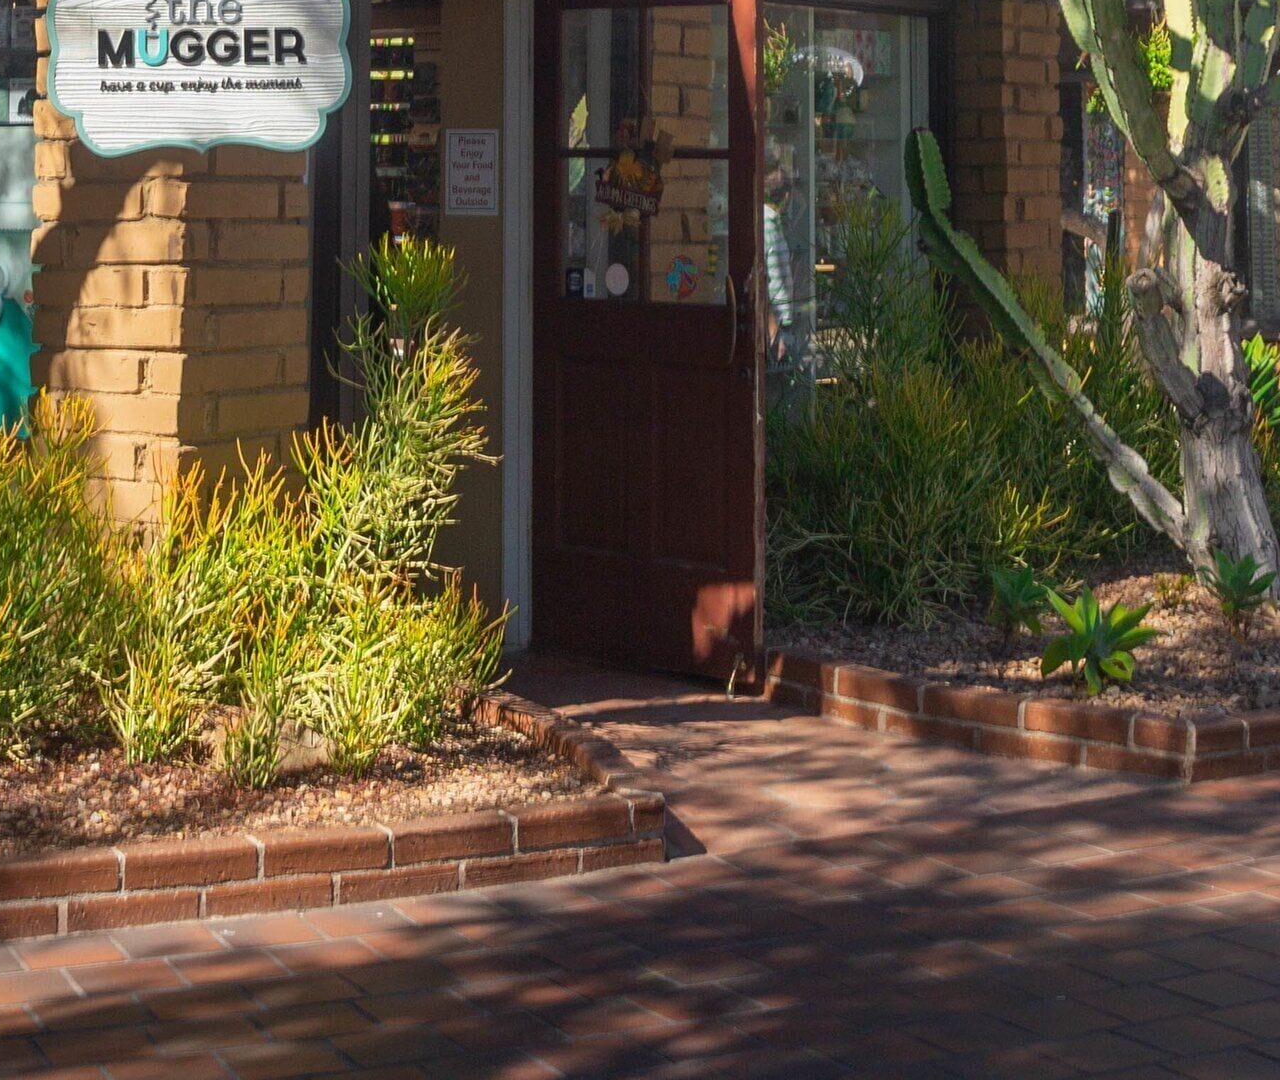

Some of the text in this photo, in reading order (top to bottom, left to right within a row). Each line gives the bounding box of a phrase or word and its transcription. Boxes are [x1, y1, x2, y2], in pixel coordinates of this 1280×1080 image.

[98, 27, 308, 68] MUGGER
[100, 79, 133, 92] have
[136, 81, 146, 91] a
[181, 77, 218, 93] enjoy
[221, 77, 242, 90] the
[458, 136, 486, 145] Please
[460, 149, 484, 159] Enjoy
[451, 160, 470, 169] Your
[464, 173, 480, 181] and
[452, 185, 492, 196] Beverage
[455, 196, 489, 206] Outside
